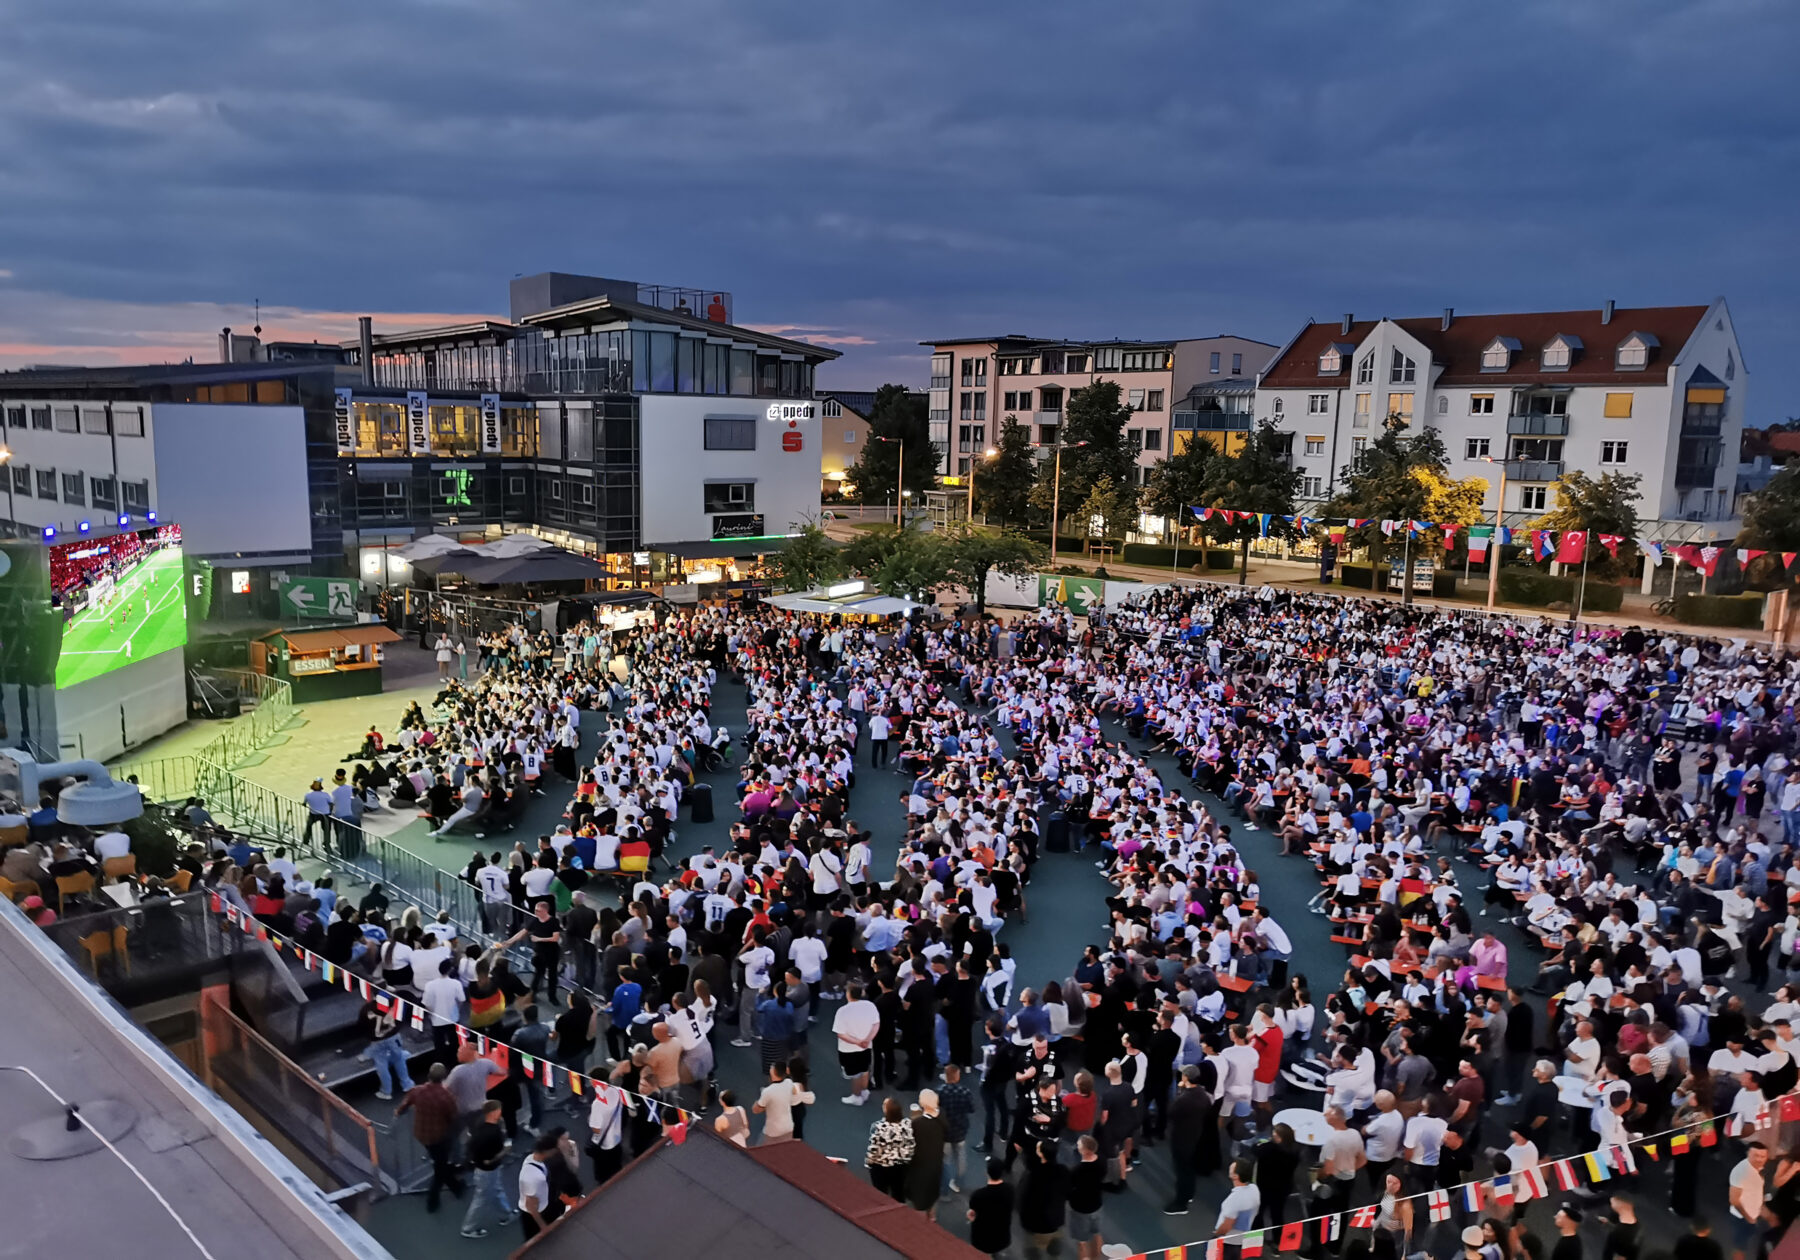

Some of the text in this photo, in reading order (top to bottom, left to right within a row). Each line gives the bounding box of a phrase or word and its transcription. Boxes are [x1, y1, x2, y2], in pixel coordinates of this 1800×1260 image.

[783, 405, 815, 418] ppedv
[335, 408, 351, 447] ppedv
[411, 410, 426, 448] ppedv
[485, 411, 498, 448] ppedv
[294, 658, 330, 671] ESSEN
[528, 757, 535, 768] 8
[486, 877, 495, 891] 7
[712, 906, 723, 920] 11
[691, 1021, 702, 1039] 9
